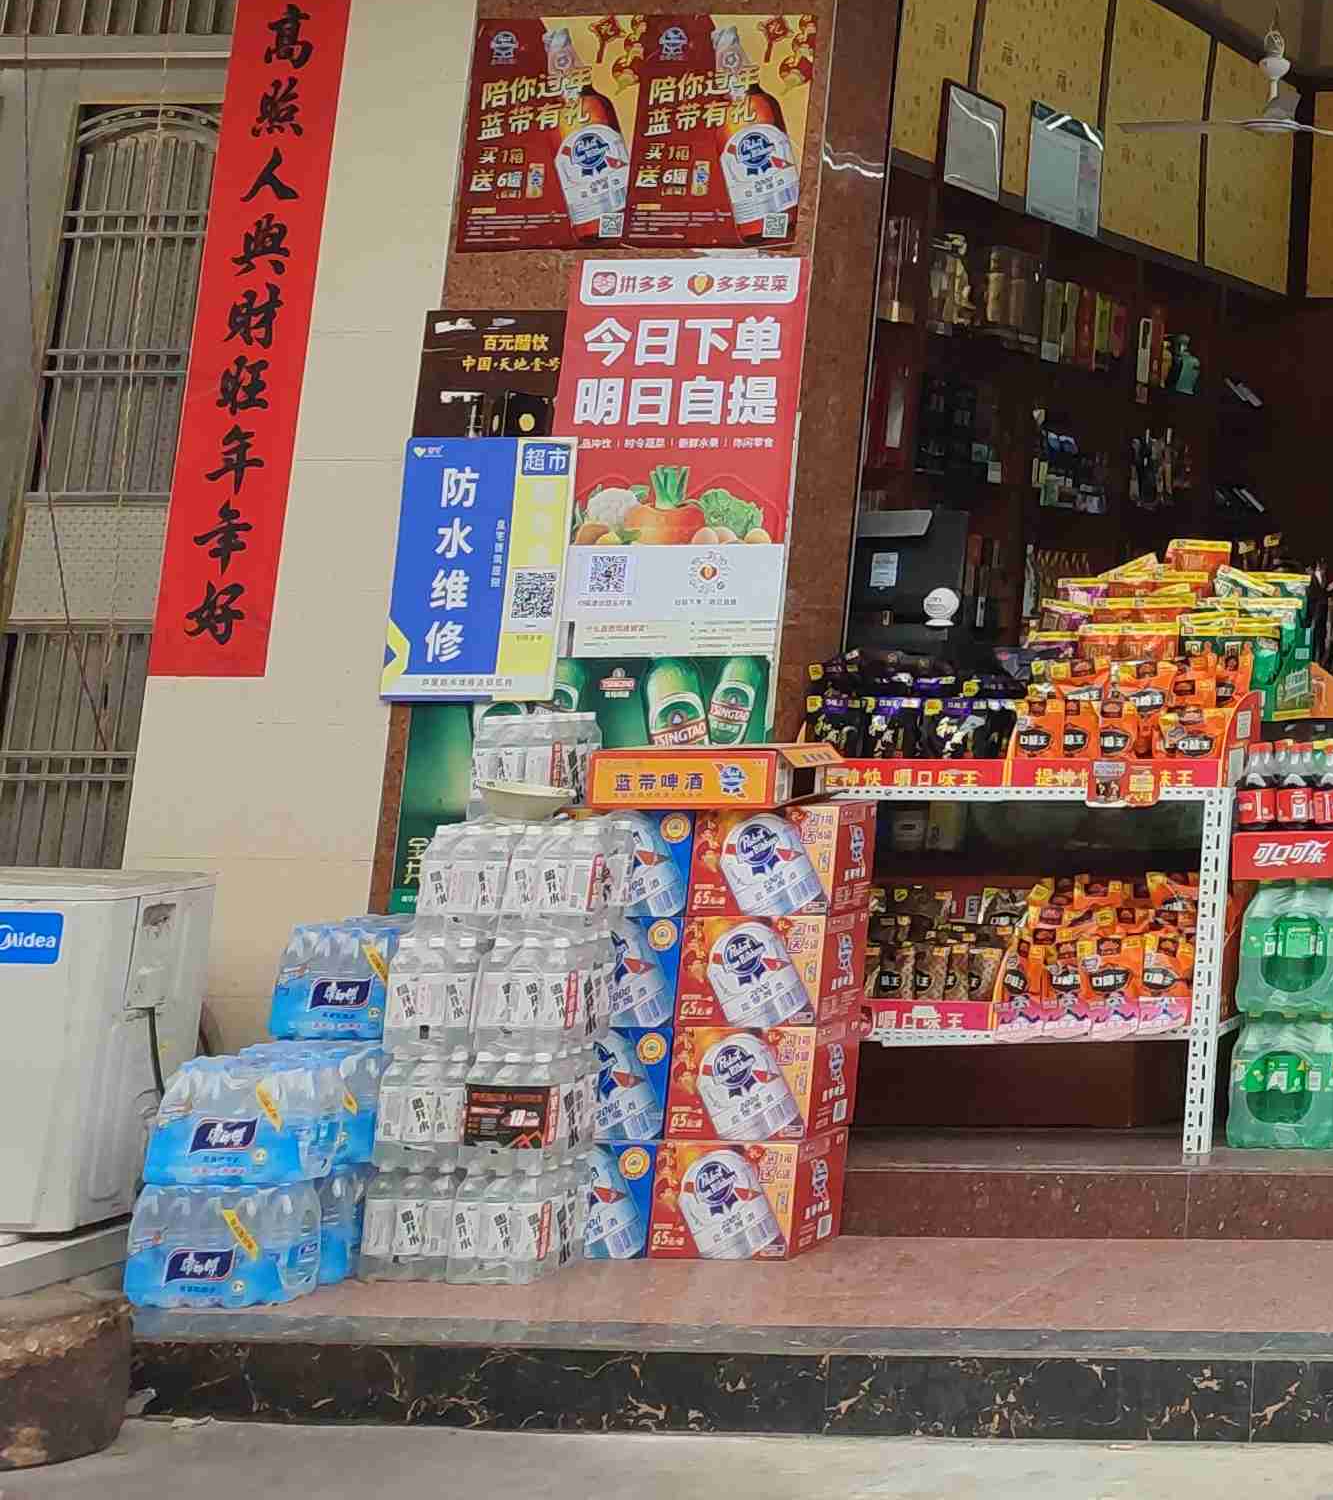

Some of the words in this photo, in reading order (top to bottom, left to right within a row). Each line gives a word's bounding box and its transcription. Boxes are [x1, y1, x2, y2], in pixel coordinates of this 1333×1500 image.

[480, 66, 594, 110] 陪你过年
[649, 66, 763, 106] 陪你过年
[477, 97, 592, 141] 蓝带有礼
[644, 97, 757, 137] 蓝带有礼
[619, 275, 674, 293] 拼多多
[716, 274, 790, 293] 多多买菜
[583, 315, 782, 367] 今日下单
[573, 375, 777, 426] 明日自提
[523, 446, 569, 472] 超市
[424, 466, 480, 665] 防水维修
[614, 772, 703, 792] 蓝带啤酒
[1252, 839, 1331, 867] 可口可乐
[8, 926, 56, 951] Midea
